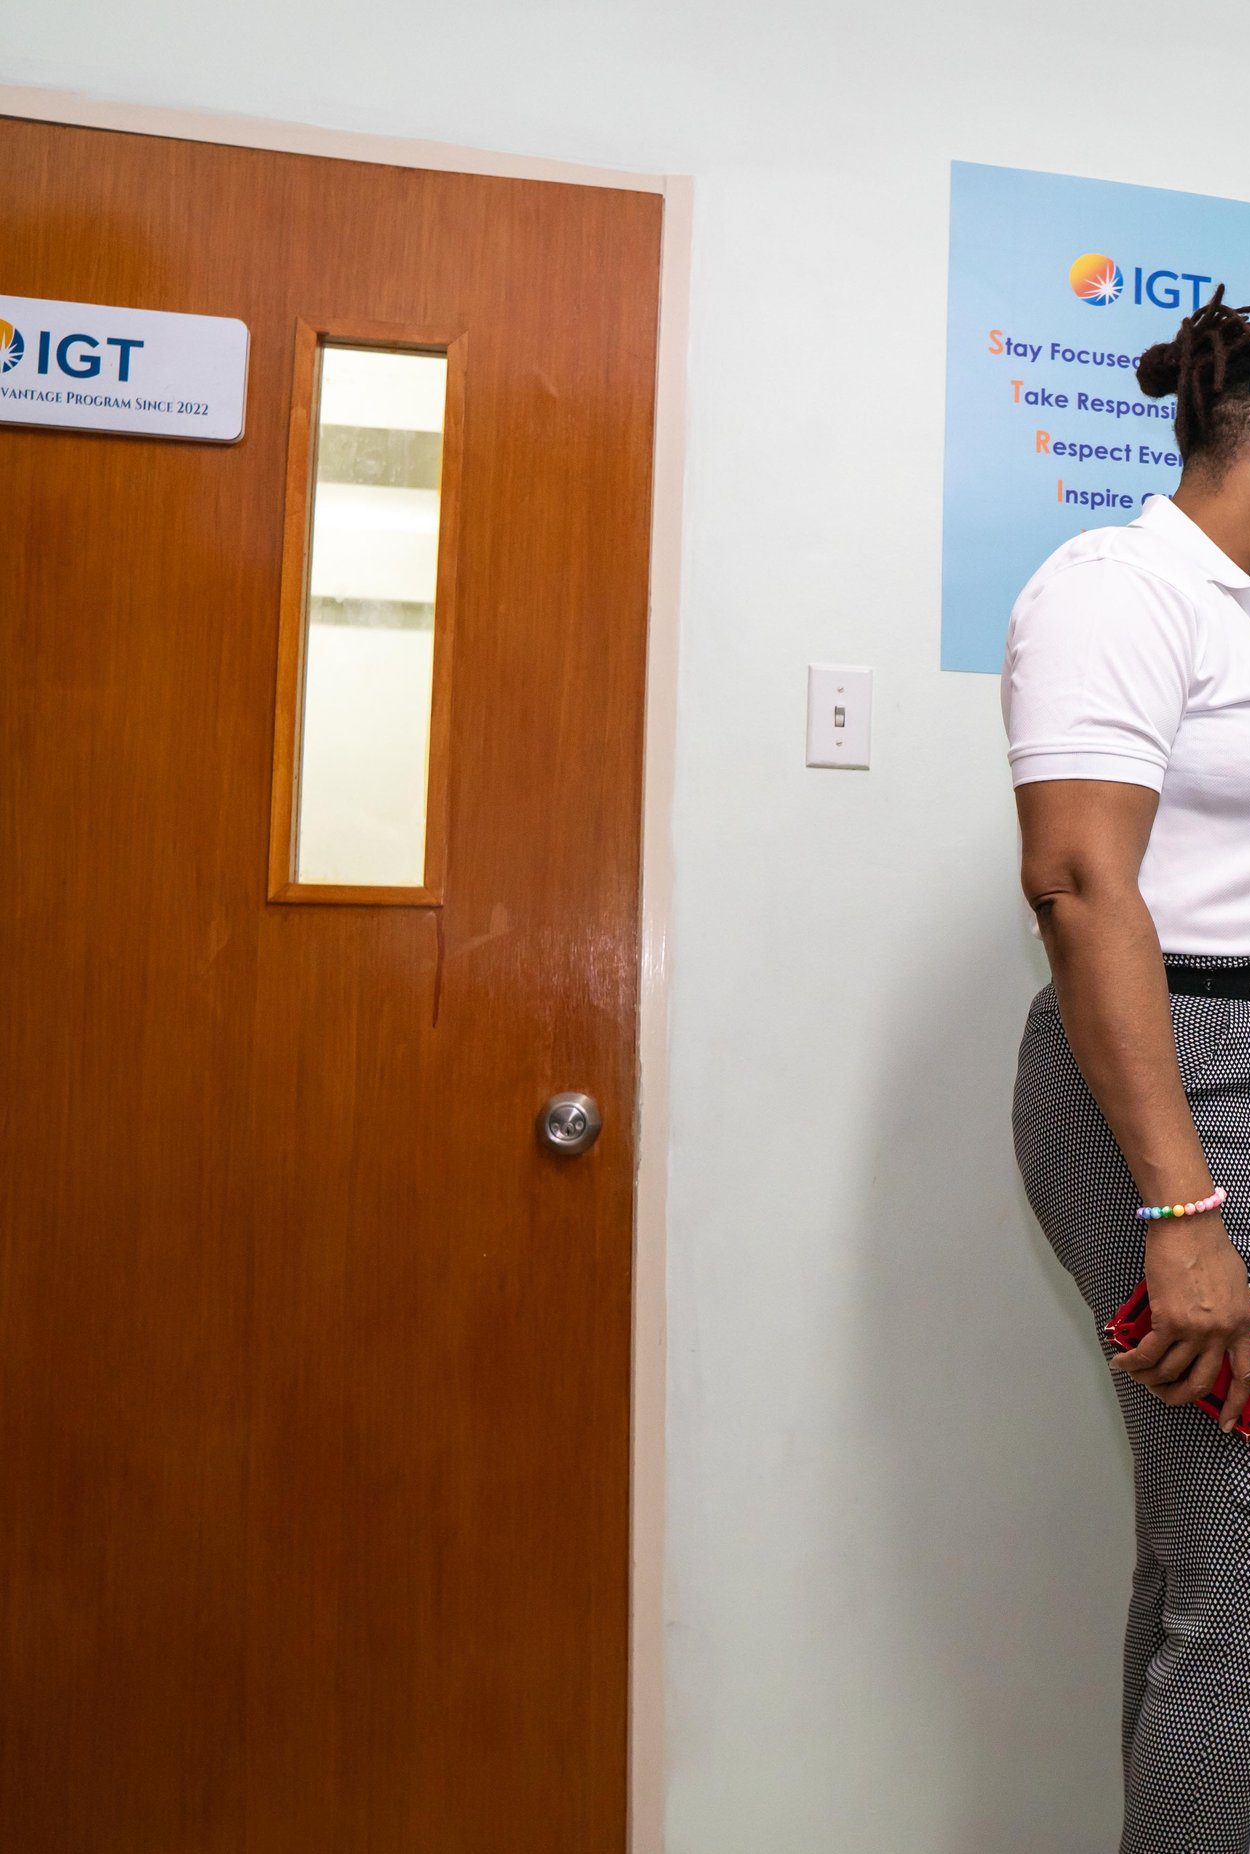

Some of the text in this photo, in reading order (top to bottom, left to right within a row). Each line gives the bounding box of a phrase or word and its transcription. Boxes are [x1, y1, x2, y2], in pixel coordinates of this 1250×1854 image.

[1134, 266, 1212, 312] IGT
[37, 330, 144, 382] IGT
[988, 329, 1042, 362] Stay
[177, 400, 209, 416] 2022
[1011, 379, 1068, 409] Take
[1036, 430, 1131, 462] Respect
[1057, 479, 1134, 510] Inspire
